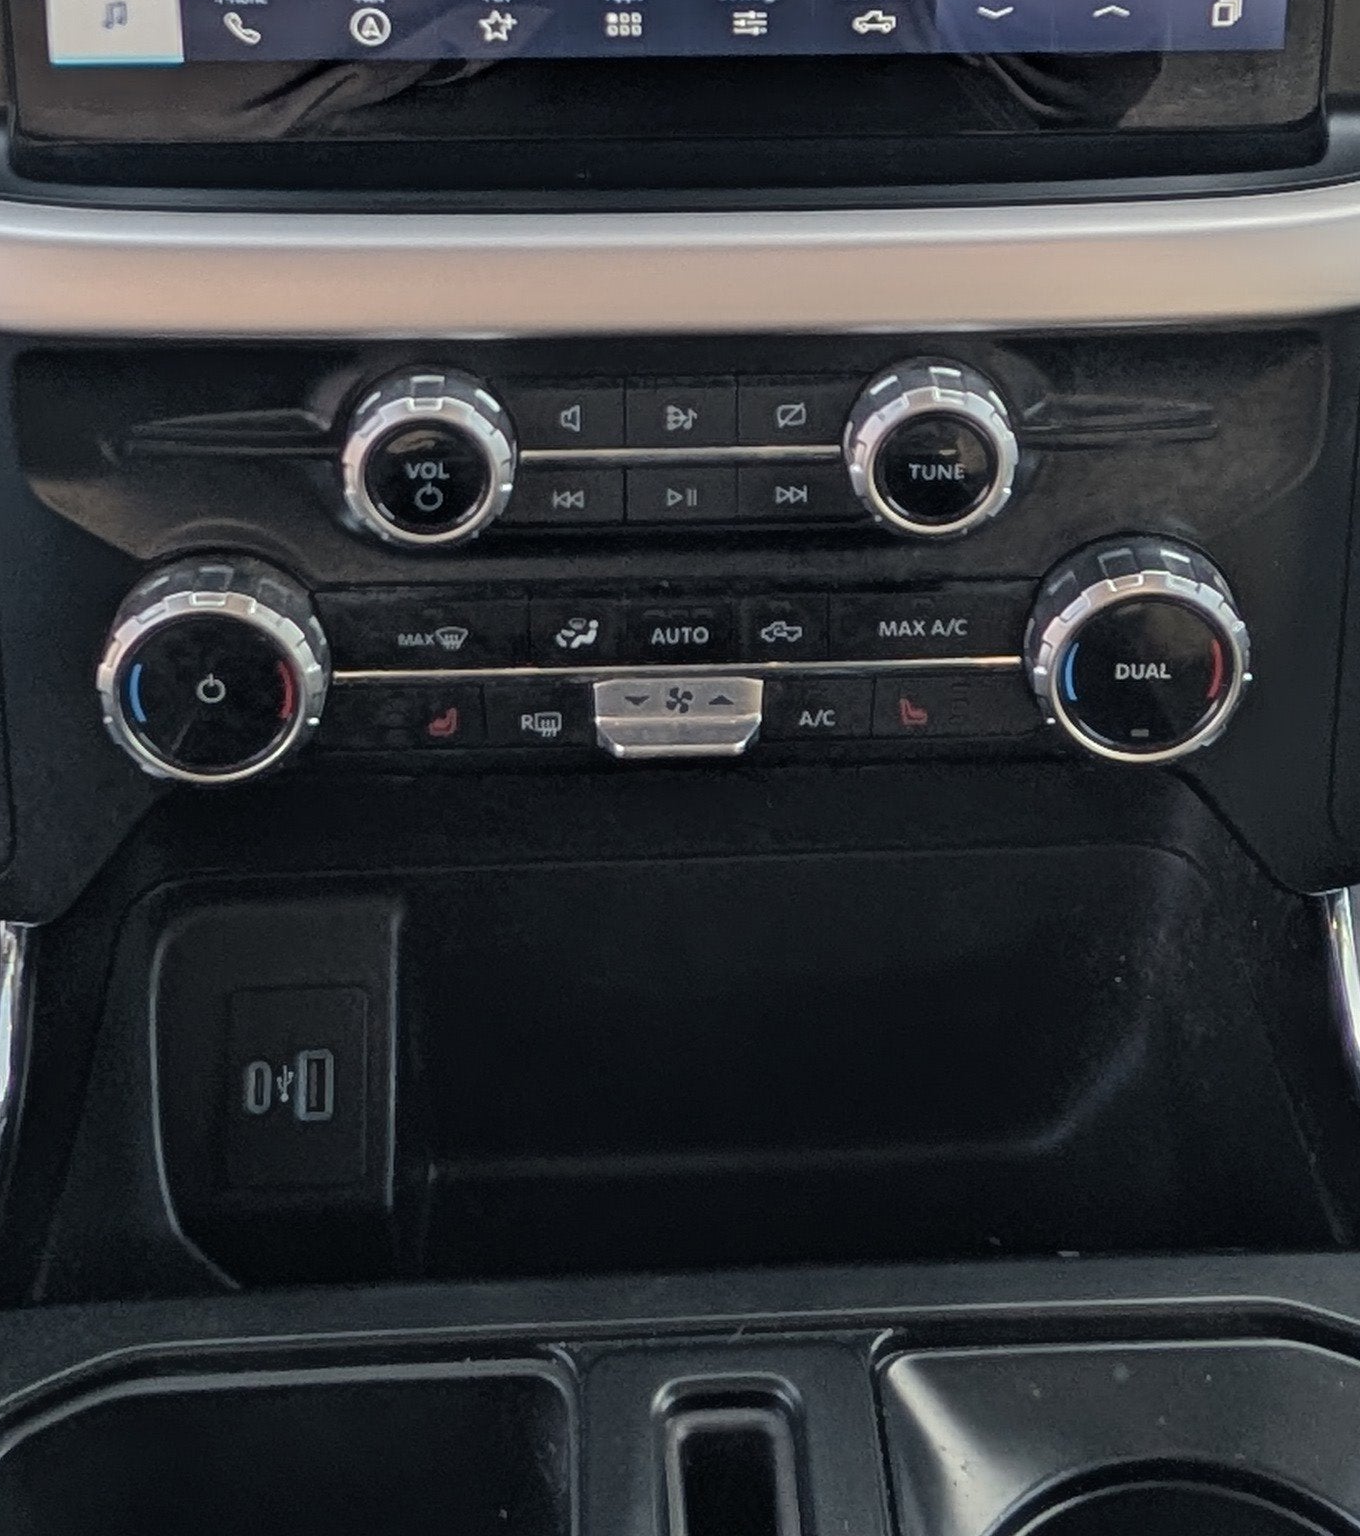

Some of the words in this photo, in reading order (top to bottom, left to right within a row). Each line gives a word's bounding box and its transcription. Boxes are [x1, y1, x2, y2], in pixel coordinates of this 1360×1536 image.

[405, 461, 450, 480] VOL
[908, 462, 966, 481] TUNE
[651, 626, 709, 645] AUTO
[878, 619, 926, 638] MAX
[931, 618, 968, 638] A/C
[398, 632, 434, 647] MAX
[1114, 662, 1172, 681] DUAL
[799, 710, 836, 727] A/C
